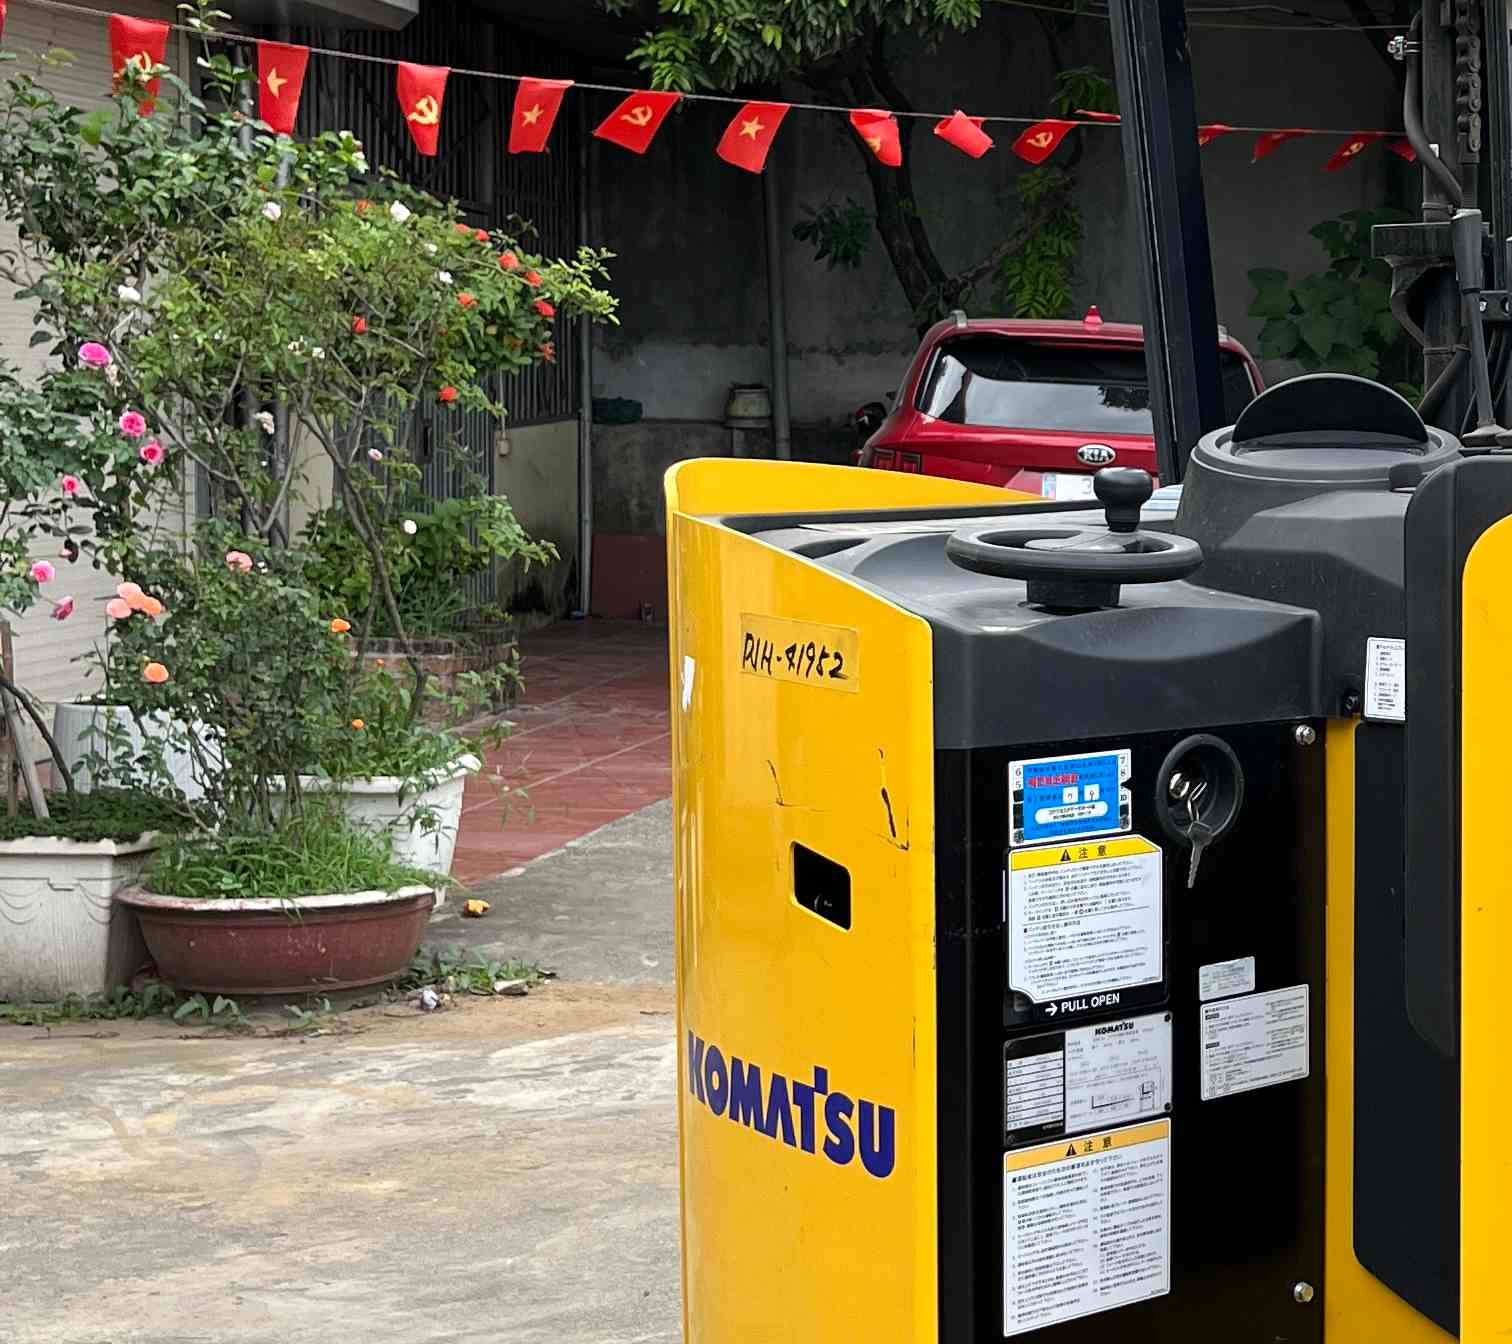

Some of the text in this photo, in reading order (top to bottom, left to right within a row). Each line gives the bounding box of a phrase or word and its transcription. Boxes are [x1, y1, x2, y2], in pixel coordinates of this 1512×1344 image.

[1061, 992, 1120, 1013] PULL OPEN
[1094, 1021, 1135, 1036] KOMATSU
[688, 1029, 896, 1179] KOMATSU
